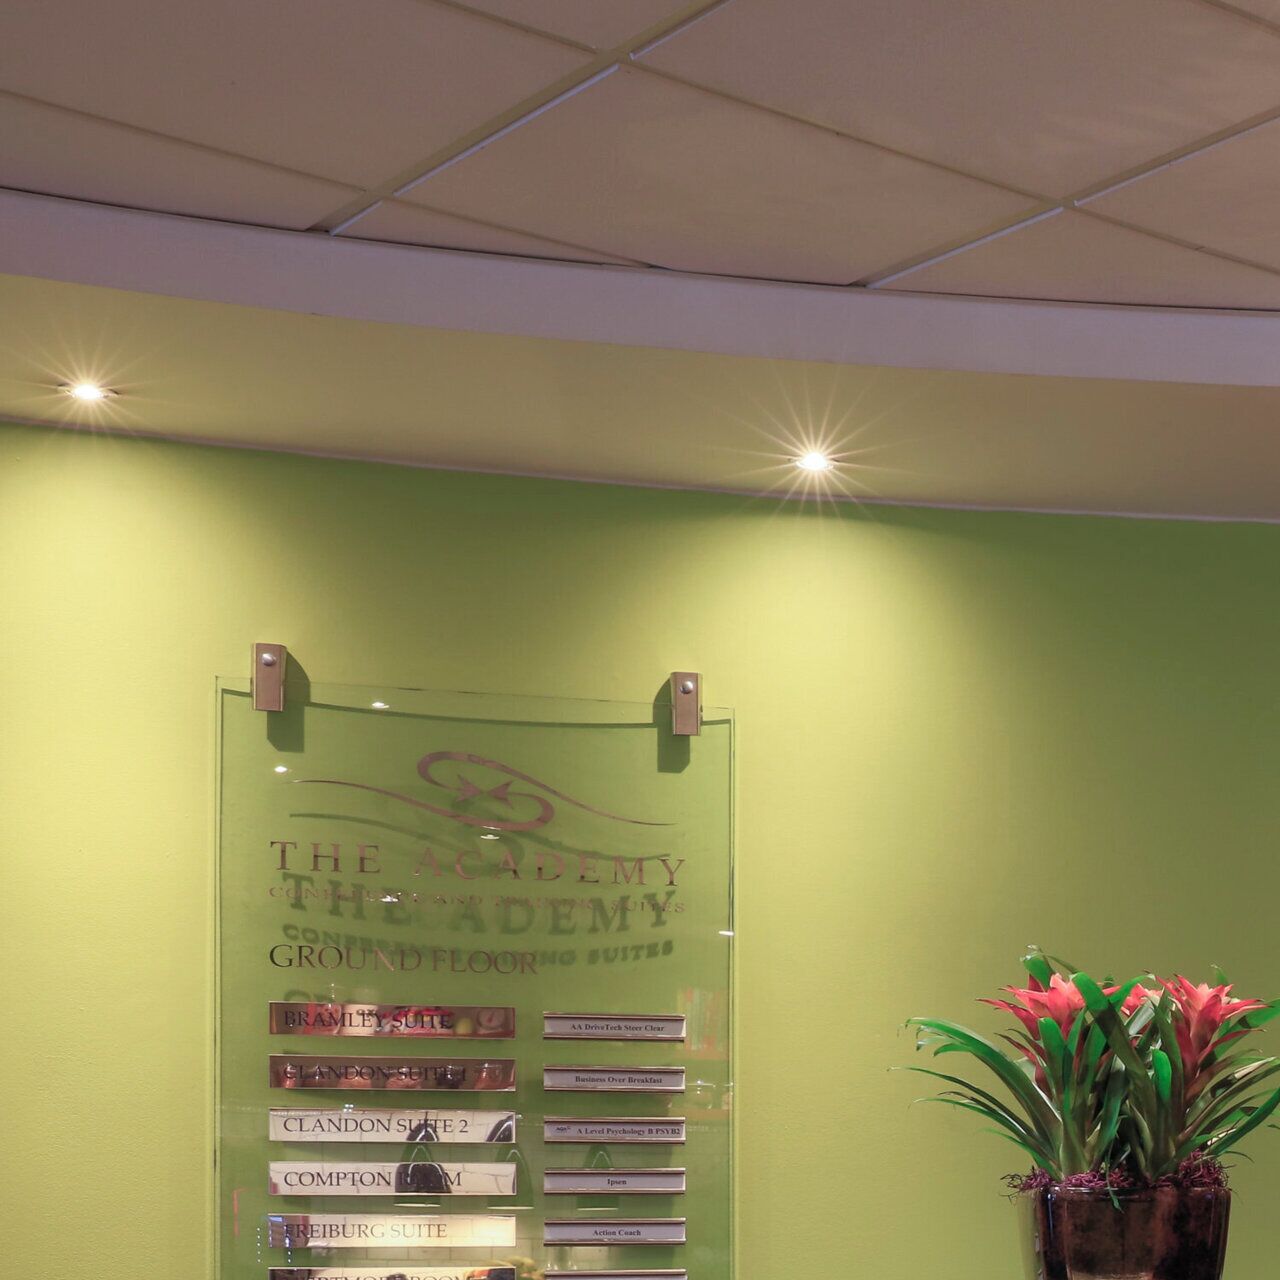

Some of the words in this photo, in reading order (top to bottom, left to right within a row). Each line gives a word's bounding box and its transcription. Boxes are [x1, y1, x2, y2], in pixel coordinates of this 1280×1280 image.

[270, 841, 380, 873] THE
[412, 847, 685, 887] ACADEMY
[269, 944, 422, 972] GROUND
[432, 949, 538, 975] FLOOR
[284, 1010, 385, 1029] BRAMLEY
[392, 1012, 454, 1031] SUITE
[644, 1024, 664, 1032] Clear
[283, 1065, 391, 1081] CLANDON
[628, 1076, 662, 1084] Breakfast
[283, 1118, 391, 1133] CLANDON
[397, 1118, 454, 1134] SUITE
[458, 1119, 469, 1133] 2
[577, 1127, 583, 1135] A
[585, 1127, 603, 1135] Level
[606, 1127, 645, 1137] Psychology
[655, 1127, 680, 1135] PSYB2
[284, 1171, 391, 1187] COMPTON
[607, 1178, 627, 1186] Ipsen
[285, 1222, 385, 1239] FREIBURG
[391, 1223, 448, 1239] SUITE
[618, 1229, 641, 1237] Coach
